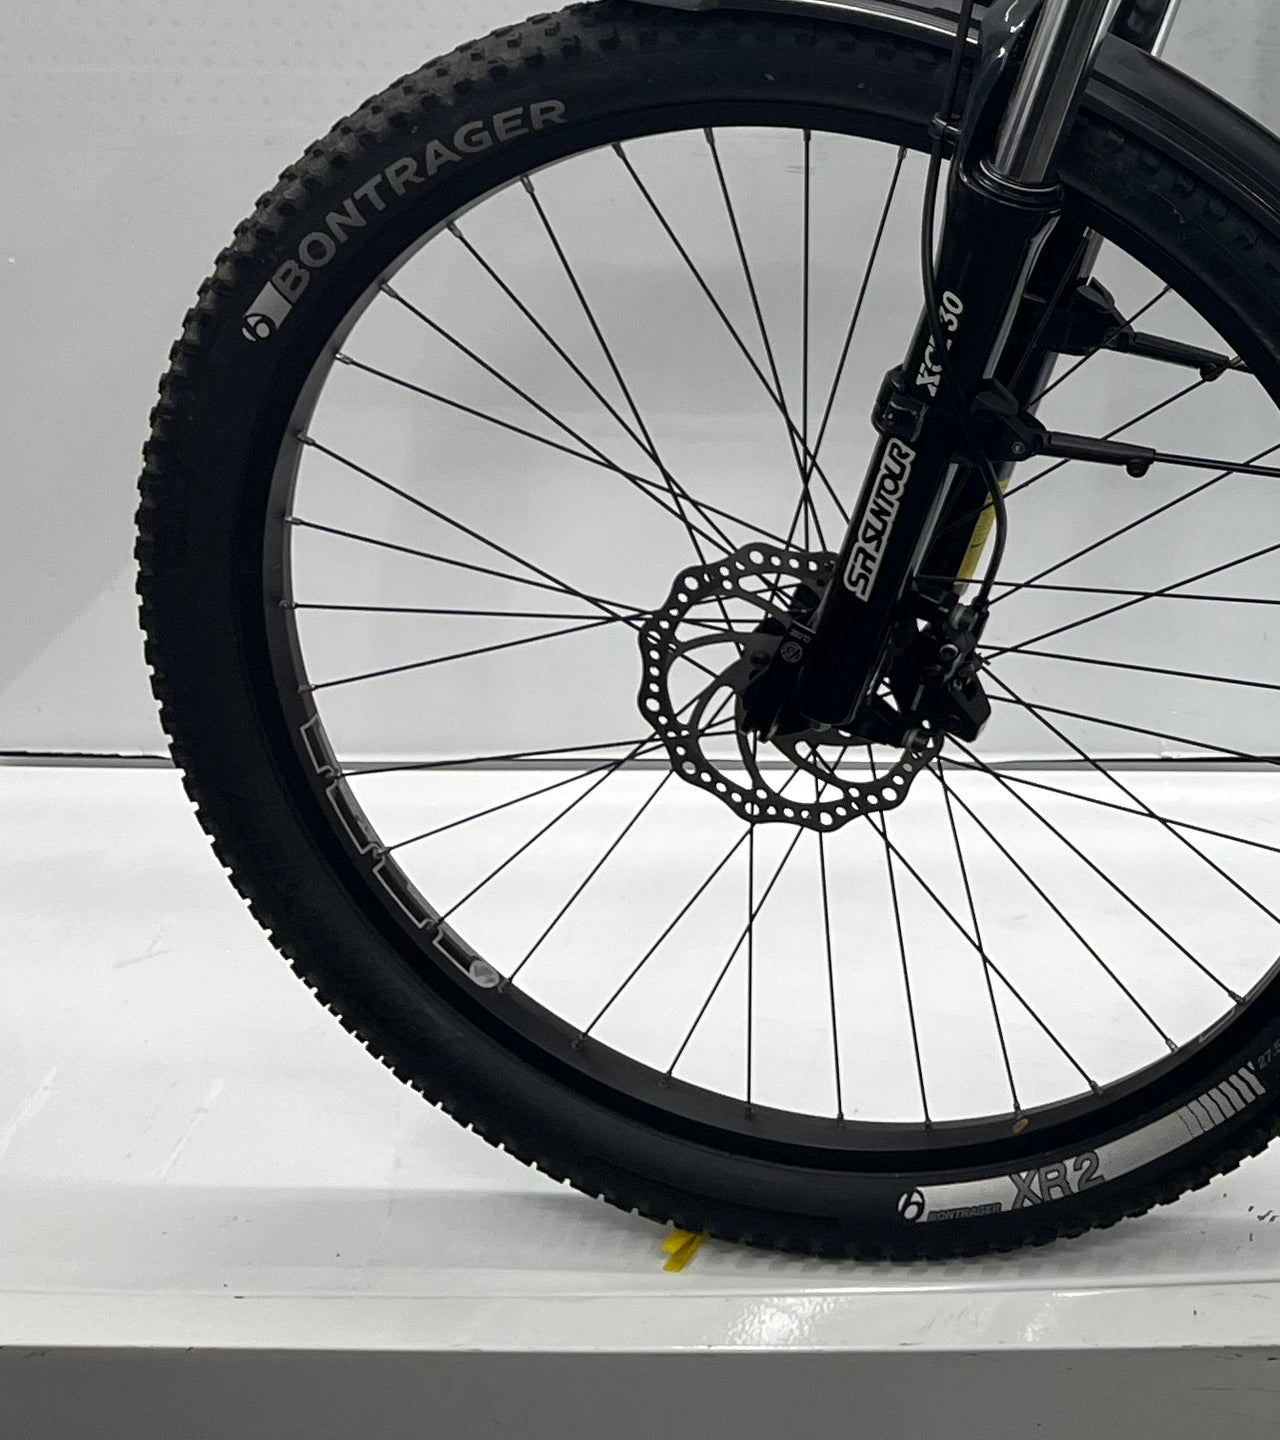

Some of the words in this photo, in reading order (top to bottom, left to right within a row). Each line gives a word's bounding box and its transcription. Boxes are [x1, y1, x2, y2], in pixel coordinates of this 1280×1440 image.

[271, 99, 568, 305] BONTRAGER
[915, 333, 953, 398] XC
[939, 290, 964, 332] 30
[859, 439, 914, 554] SUNTOUR
[844, 544, 880, 601] SR
[1008, 1150, 1107, 1211] XR2
